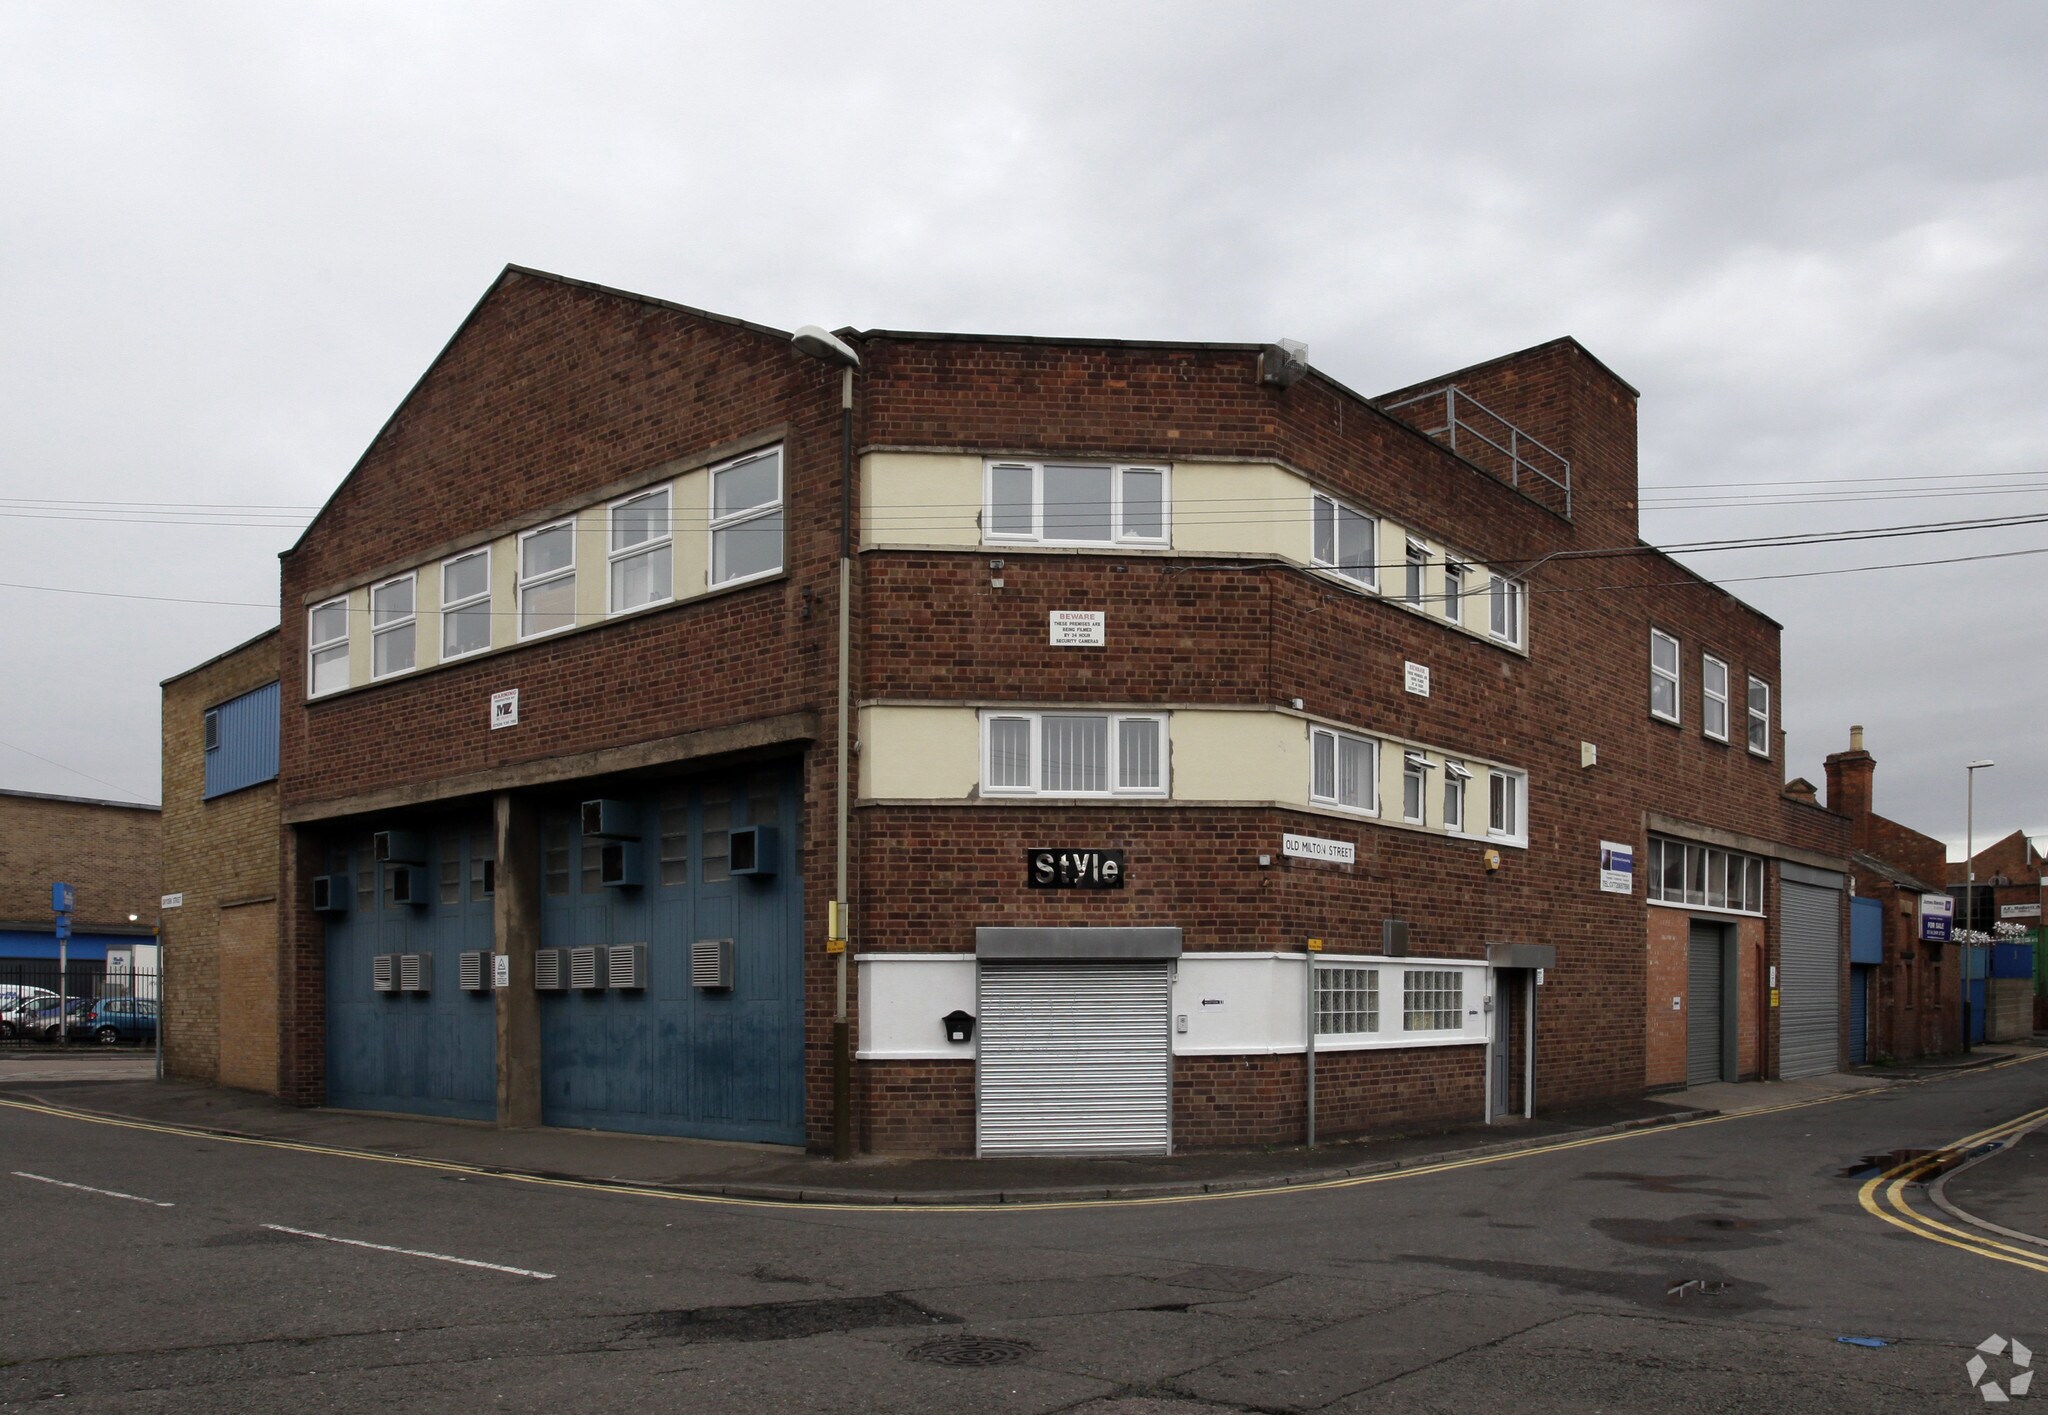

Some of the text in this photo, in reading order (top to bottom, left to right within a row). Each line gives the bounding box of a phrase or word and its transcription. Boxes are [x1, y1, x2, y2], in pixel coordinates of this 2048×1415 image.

[496, 702, 512, 717] MZ
[1285, 839, 1353, 858] OLD MILTON STREET
